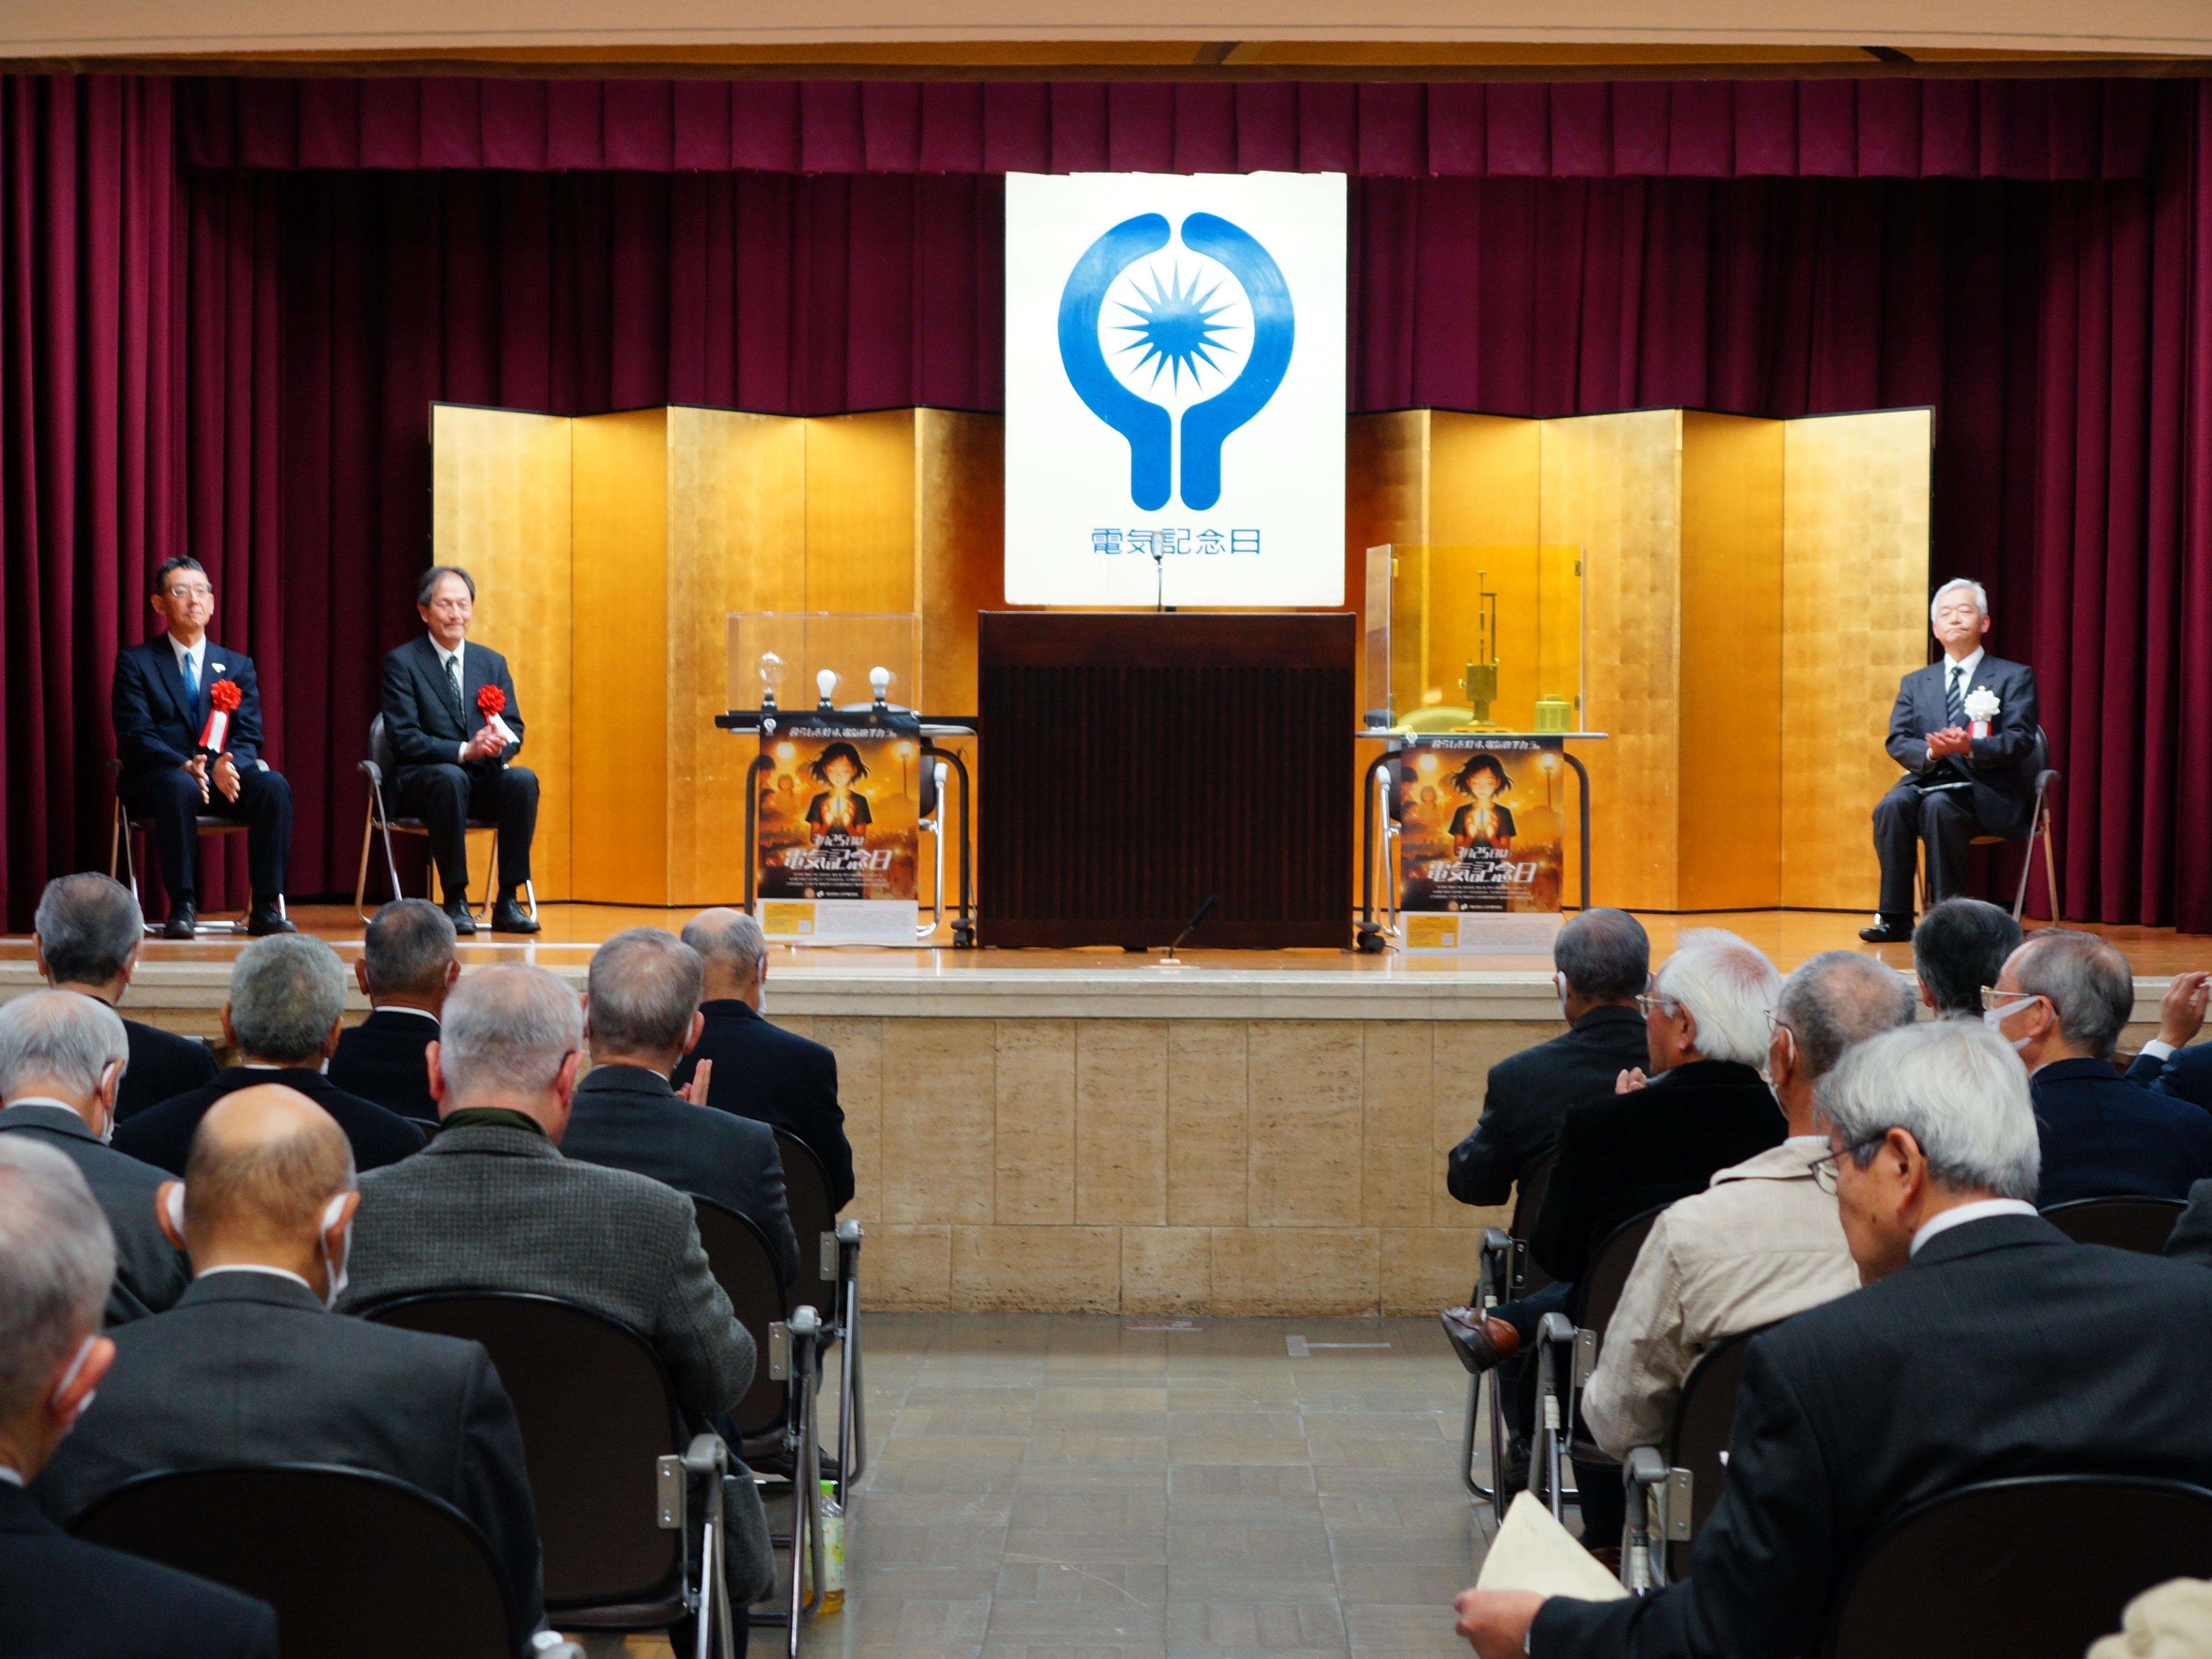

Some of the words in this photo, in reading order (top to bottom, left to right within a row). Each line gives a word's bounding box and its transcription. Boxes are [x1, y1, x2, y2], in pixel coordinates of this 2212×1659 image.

[1092, 528, 1261, 555] 電気記念日
[784, 848, 892, 871] 電気記念日
[1427, 861, 1538, 883] 電気記念日
